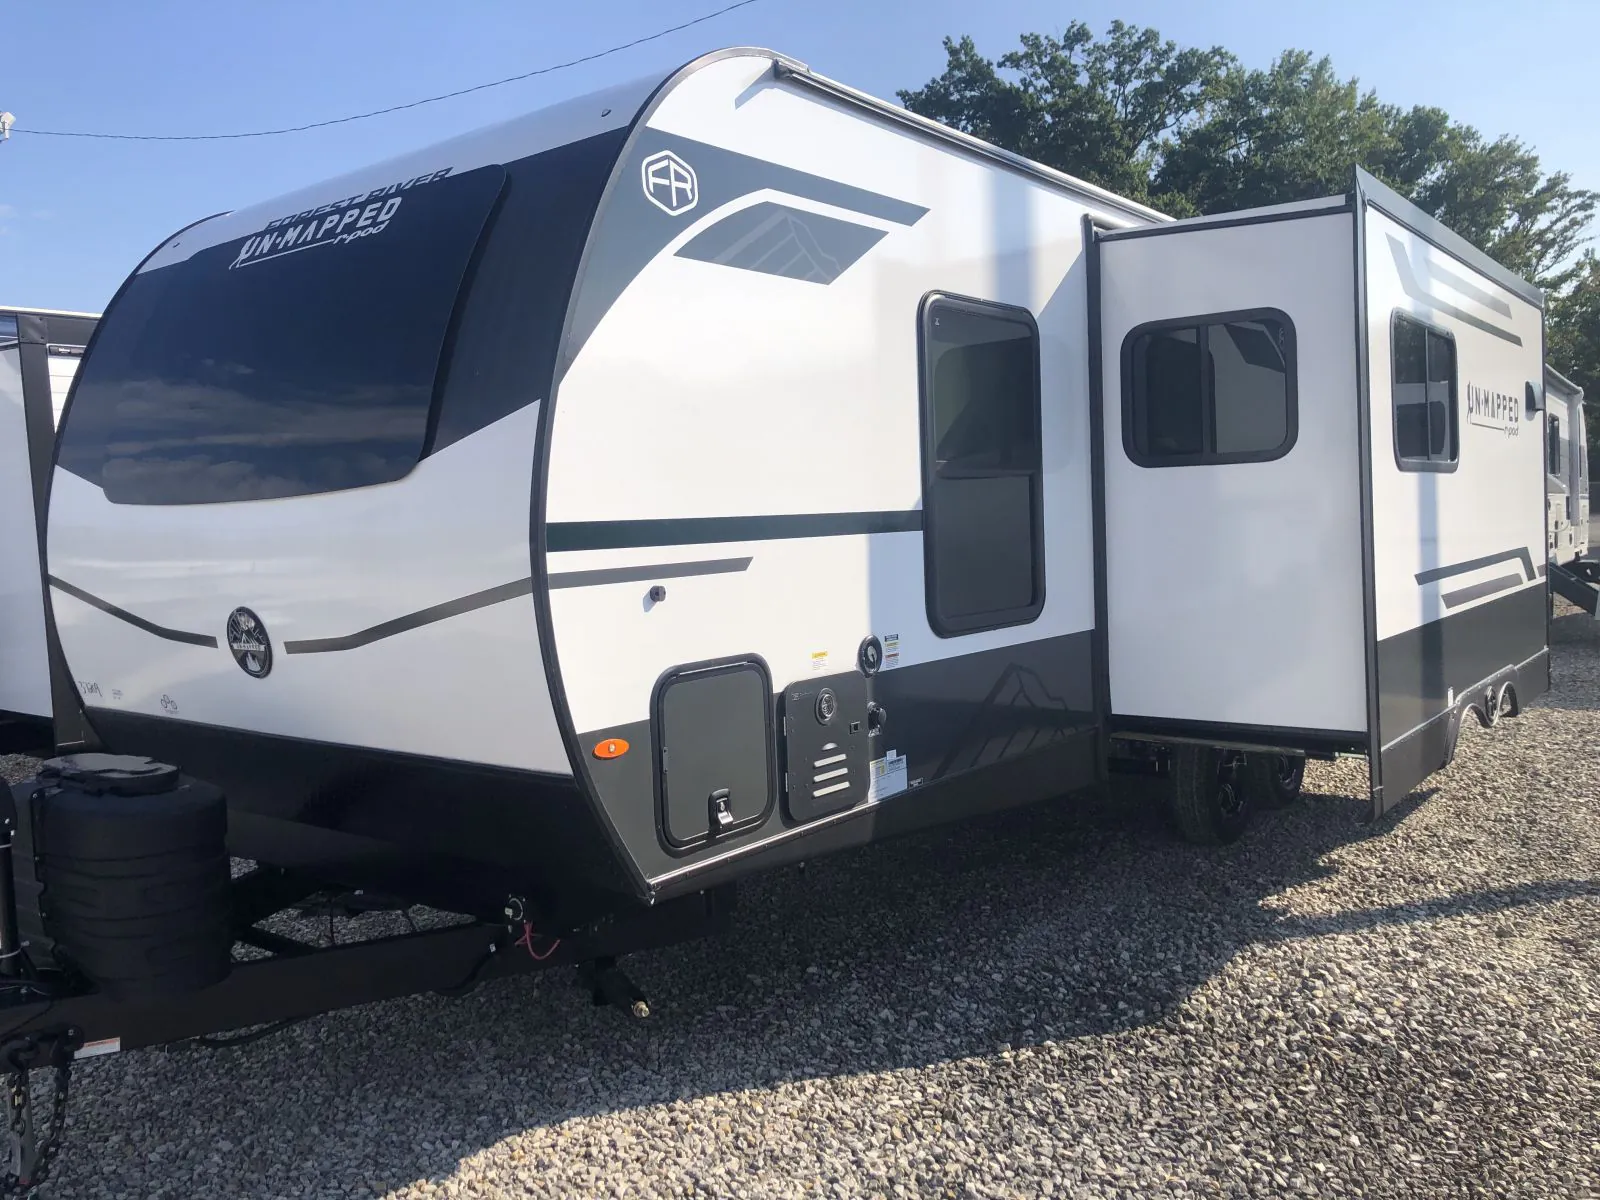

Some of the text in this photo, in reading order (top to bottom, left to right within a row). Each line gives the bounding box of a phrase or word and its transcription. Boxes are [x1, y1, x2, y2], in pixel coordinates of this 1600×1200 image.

[264, 166, 454, 231] FOREST RIVER
[647, 158, 693, 207] FR
